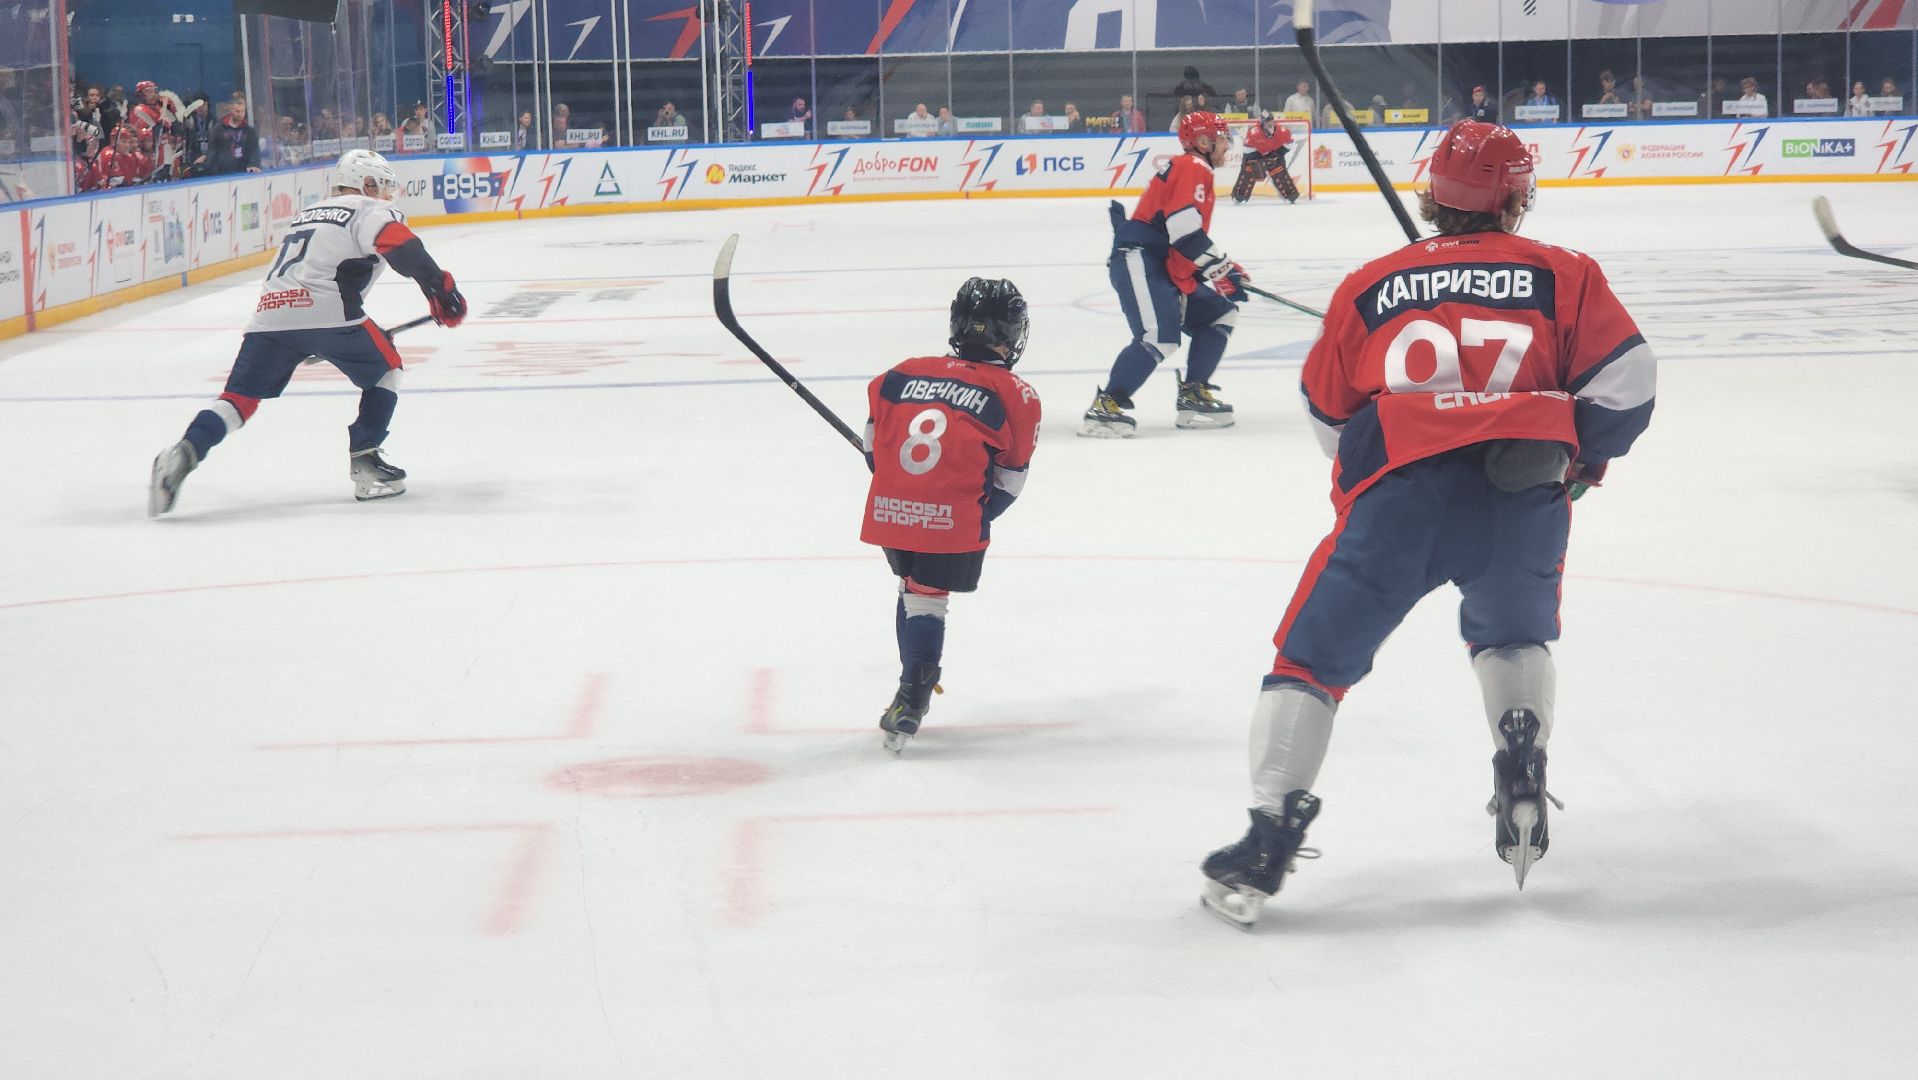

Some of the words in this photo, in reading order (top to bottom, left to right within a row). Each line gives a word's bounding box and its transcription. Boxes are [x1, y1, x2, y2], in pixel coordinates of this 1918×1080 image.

[650, 128, 686, 139] KHL.RU
[728, 164, 757, 172] Яндекс
[1043, 156, 1085, 172] ПСБ
[406, 179, 427, 197] CUP
[444, 171, 492, 199] 895
[728, 173, 787, 184] Маркет
[1376, 269, 1534, 315] КАПРИЗОВ
[1384, 318, 1534, 393] 97
[901, 379, 989, 415] ОВЕЧКИН
[900, 408, 948, 476] 8
[874, 496, 952, 518] МОСОБЛ
[873, 509, 934, 529] СПОРТ
